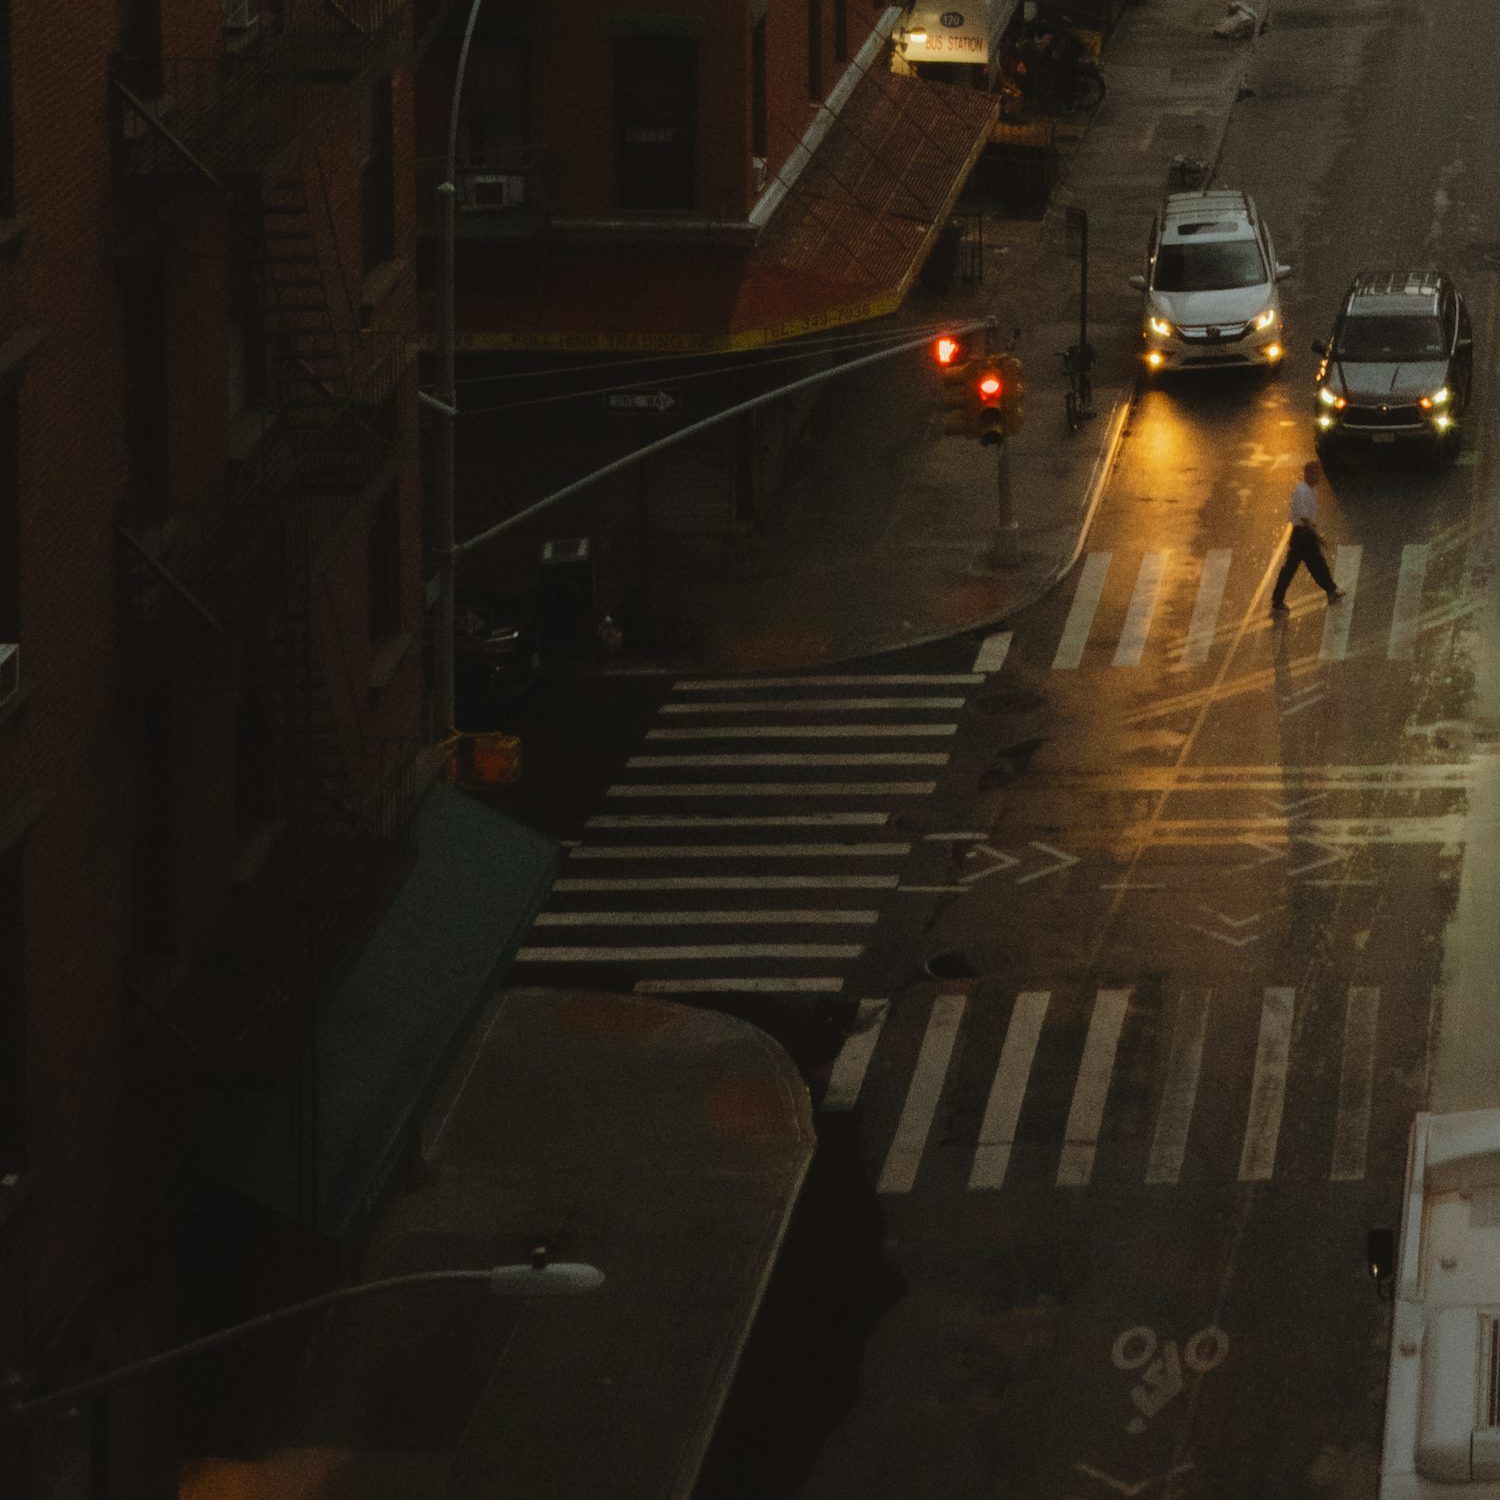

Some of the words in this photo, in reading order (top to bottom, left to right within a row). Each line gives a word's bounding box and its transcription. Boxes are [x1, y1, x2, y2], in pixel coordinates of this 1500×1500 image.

[925, 36, 943, 51] BUS
[947, 36, 984, 53] STATION
[615, 394, 635, 407] ONE
[646, 394, 667, 408] WAY
